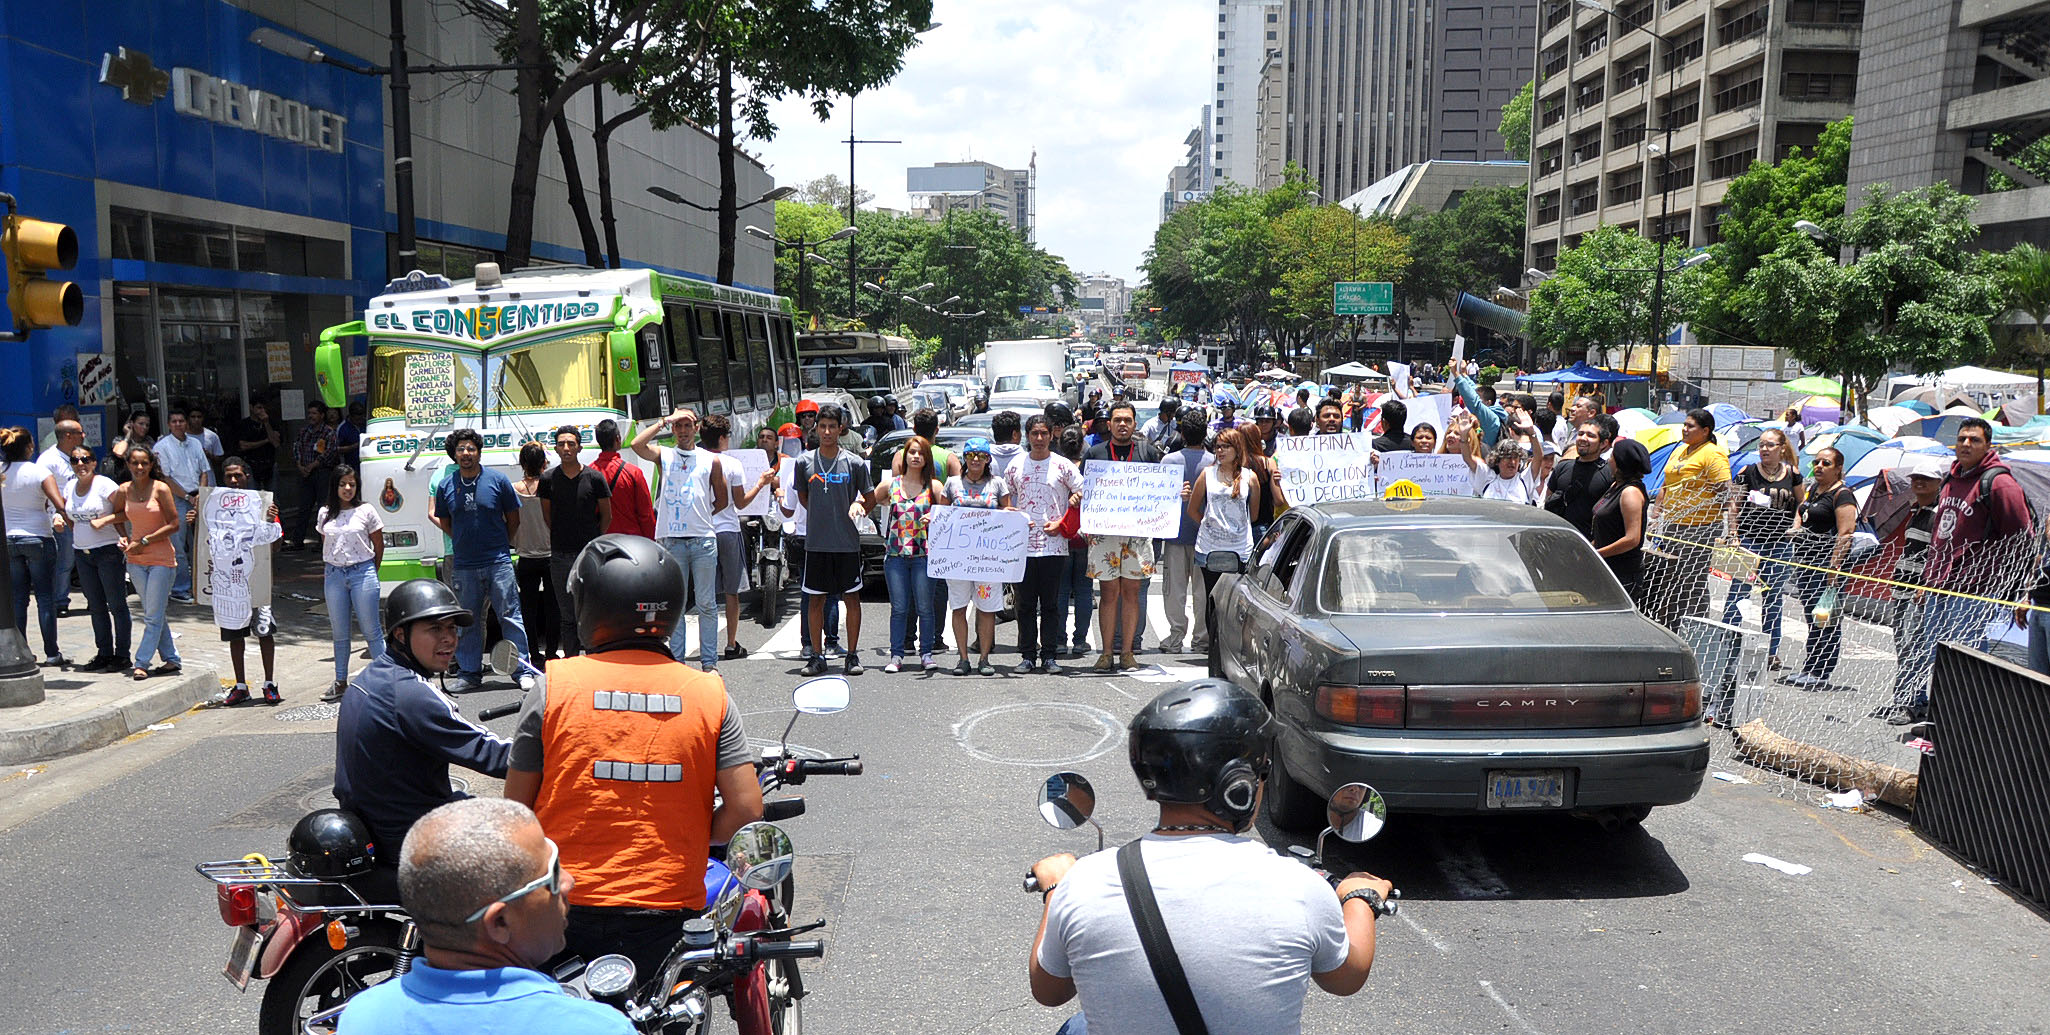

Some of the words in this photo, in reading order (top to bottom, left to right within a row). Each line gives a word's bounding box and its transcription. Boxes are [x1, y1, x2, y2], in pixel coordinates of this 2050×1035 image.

[172, 67, 347, 154] CHEVROLET
[374, 313, 408, 331] EL
[411, 302, 600, 341] CONSENTIDO
[406, 353, 453, 362] PASTORA
[408, 360, 452, 369] MIRAFLORES
[409, 367, 450, 376] CARMELITAS
[409, 374, 450, 383] URDANETA
[406, 381, 453, 390] CANDELARIA
[408, 388, 450, 397] CHACAO
[411, 395, 447, 404] RUICES
[408, 402, 452, 411] CALIFORNIA
[484, 432, 512, 448] DE
[519, 428, 594, 446] JESS
[1313, 454, 1323, 469] O
[1124, 465, 1167, 474] VENEZUELA
[1096, 478, 1124, 487] PRIMER
[1083, 489, 1105, 501] OPEP
[1315, 485, 1366, 502] DECIDES
[1394, 485, 1413, 497] TAXI
[1938, 497, 1973, 516] ARVARD
[940, 523, 971, 550] 15
[1657, 667, 1673, 675] LE
[1476, 699, 1580, 707] CAMRY
[1495, 779, 1521, 797] AAA
